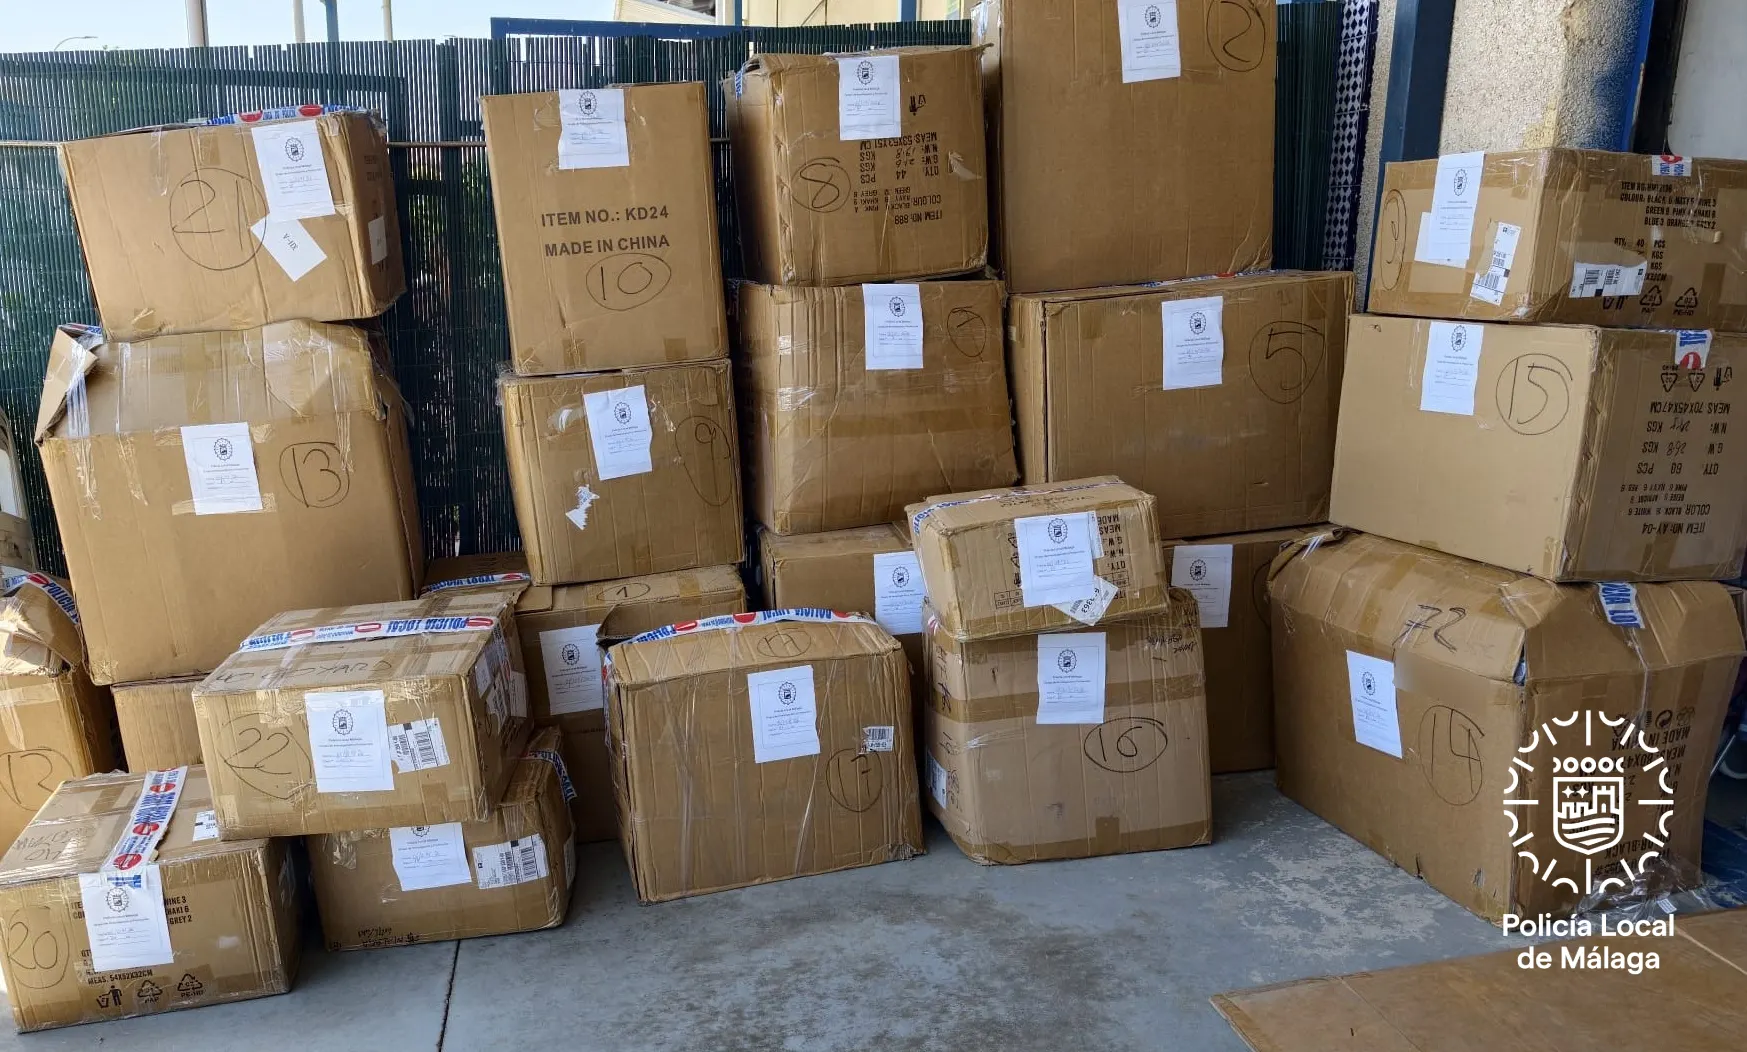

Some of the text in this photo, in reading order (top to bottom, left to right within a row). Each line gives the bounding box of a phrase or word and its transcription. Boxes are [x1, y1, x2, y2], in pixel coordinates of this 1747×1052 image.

[172, 179, 244, 252] 21
[541, 205, 670, 227] ITEM NO.: KD24
[544, 234, 670, 257] MADE IN CHINA
[292, 447, 342, 508] 13
[223, 727, 293, 776] 22
[1098, 725, 1144, 763] 16
[1662, 725, 1691, 744] MADE
[7, 921, 59, 970] 20
